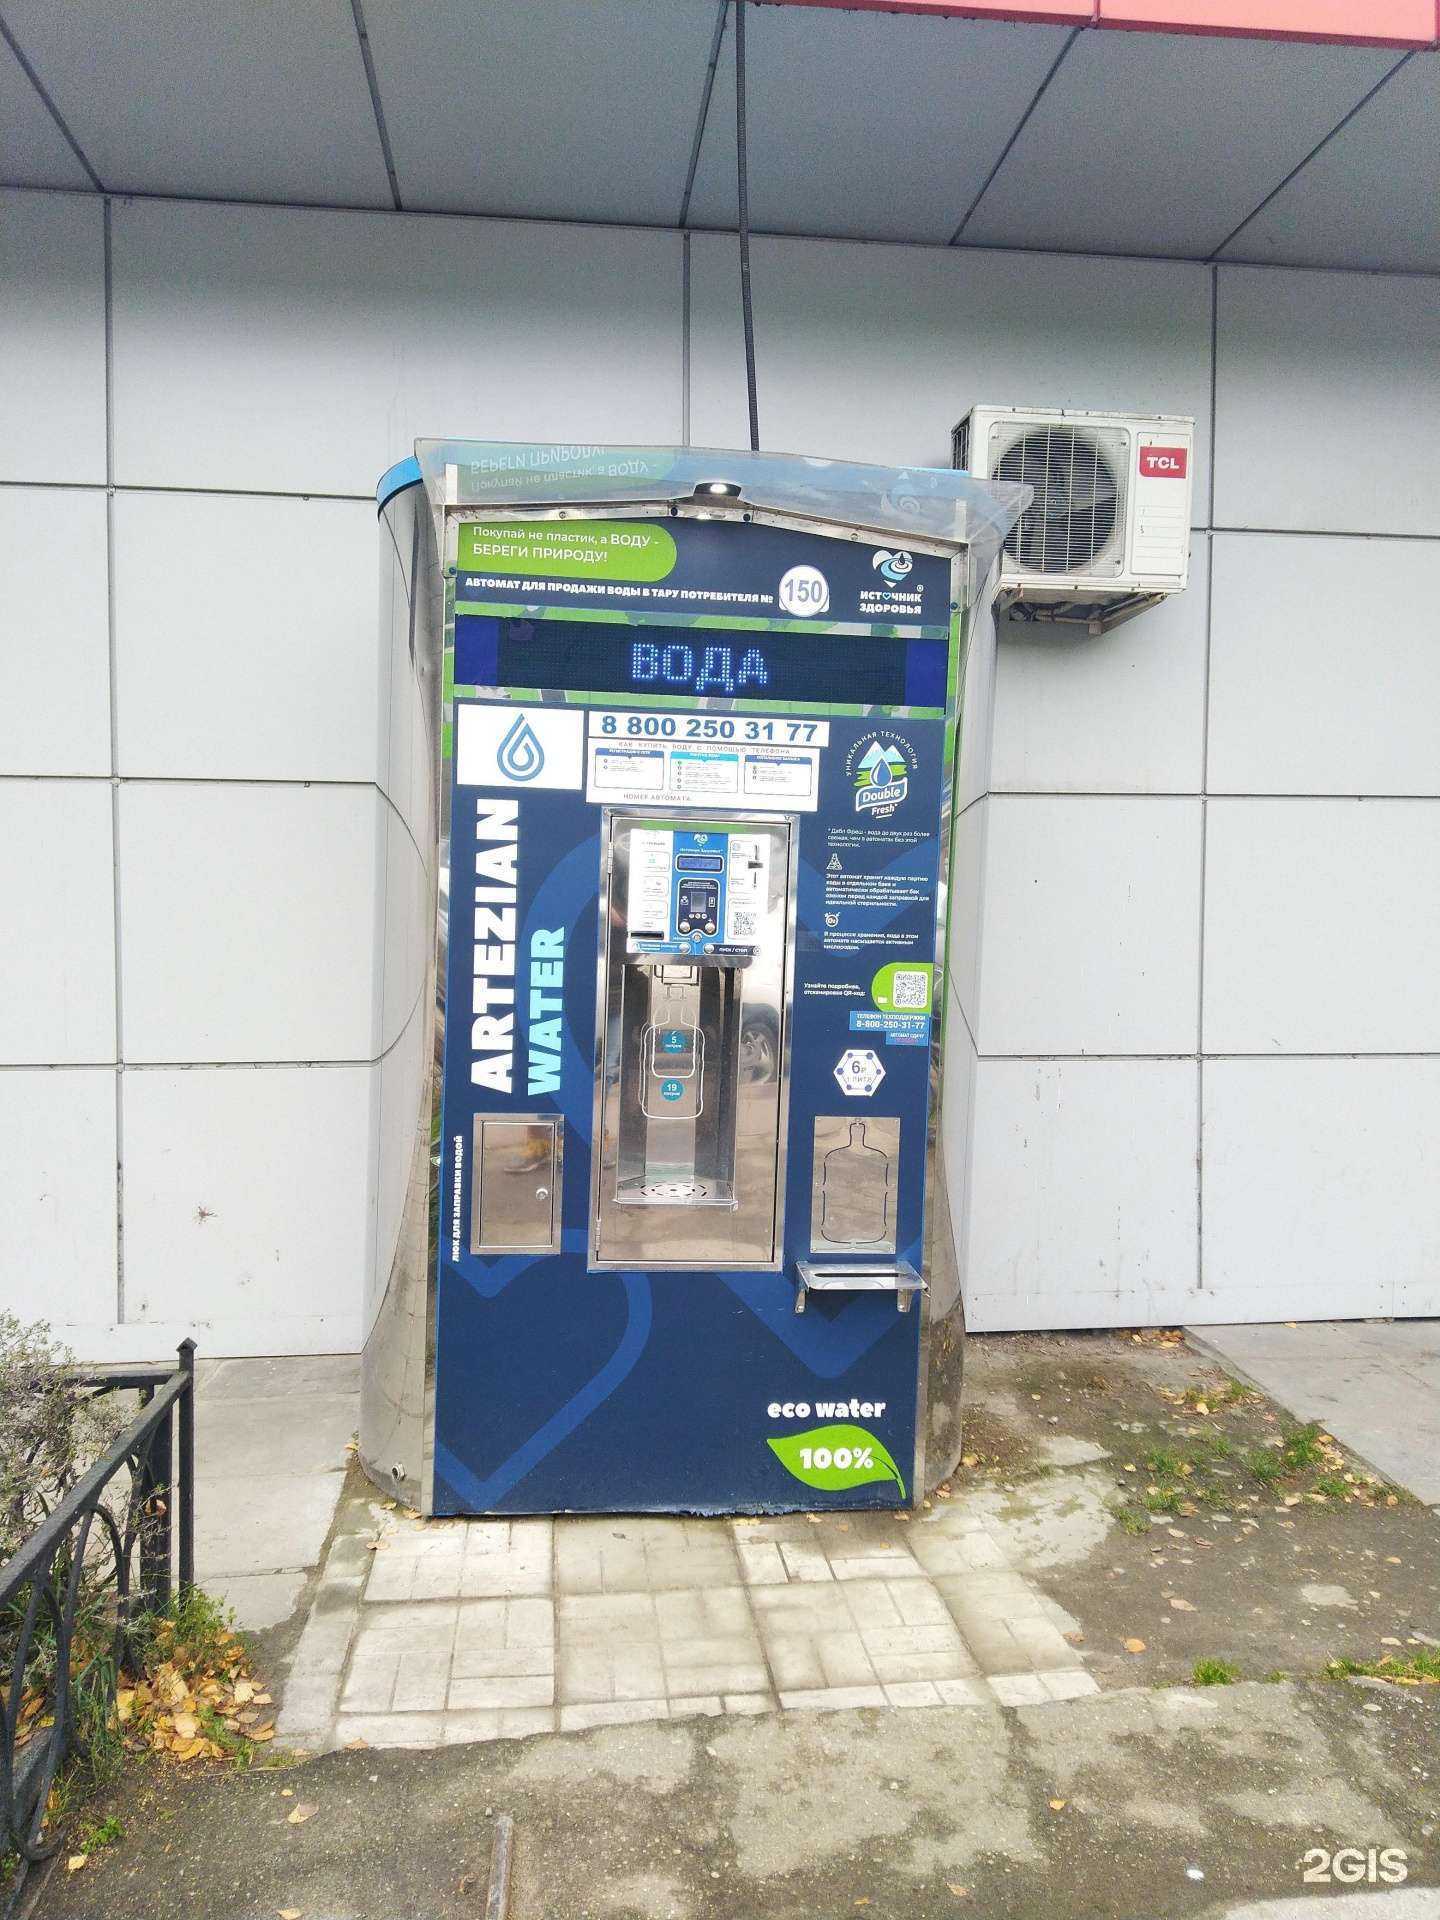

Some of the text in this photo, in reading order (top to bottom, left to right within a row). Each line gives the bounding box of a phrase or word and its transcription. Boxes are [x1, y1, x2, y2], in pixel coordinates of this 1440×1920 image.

[1147, 456, 1179, 469] TCL
[473, 526, 525, 540] Покупай
[529, 532, 543, 540] не
[546, 532, 598, 545] пластик,
[611, 534, 650, 548] ВОДУ
[473, 543, 608, 563] БЕРЕГИ ПРИРОДУ!
[465, 578, 773, 604] АВТОМАТ ДЛЯ ПРОДАЖИ ВОДЫ В ТАРУ ПОТРЕБИТЕЛЯ №
[784, 579, 823, 602] 150
[860, 603, 922, 614] ЗДОРОВЬЯ
[632, 643, 768, 691] ВОДА
[602, 715, 818, 741] 8 800 250 31 77
[845, 731, 918, 777] УНИКАЛЬНАЯ ТЕХНОЛОГИЯ
[863, 787, 901, 803] Double
[471, 799, 519, 1094] ARTEZIAN
[528, 926, 566, 1096] WATER
[856, 1020, 925, 1029] 8-800-250-31-77
[452, 1136, 462, 1262] ЛЮК ДЛЯ ЗАПРАВКИ ВОДОЙ
[767, 1399, 886, 1418] eco water
[800, 1447, 874, 1469] 100%
